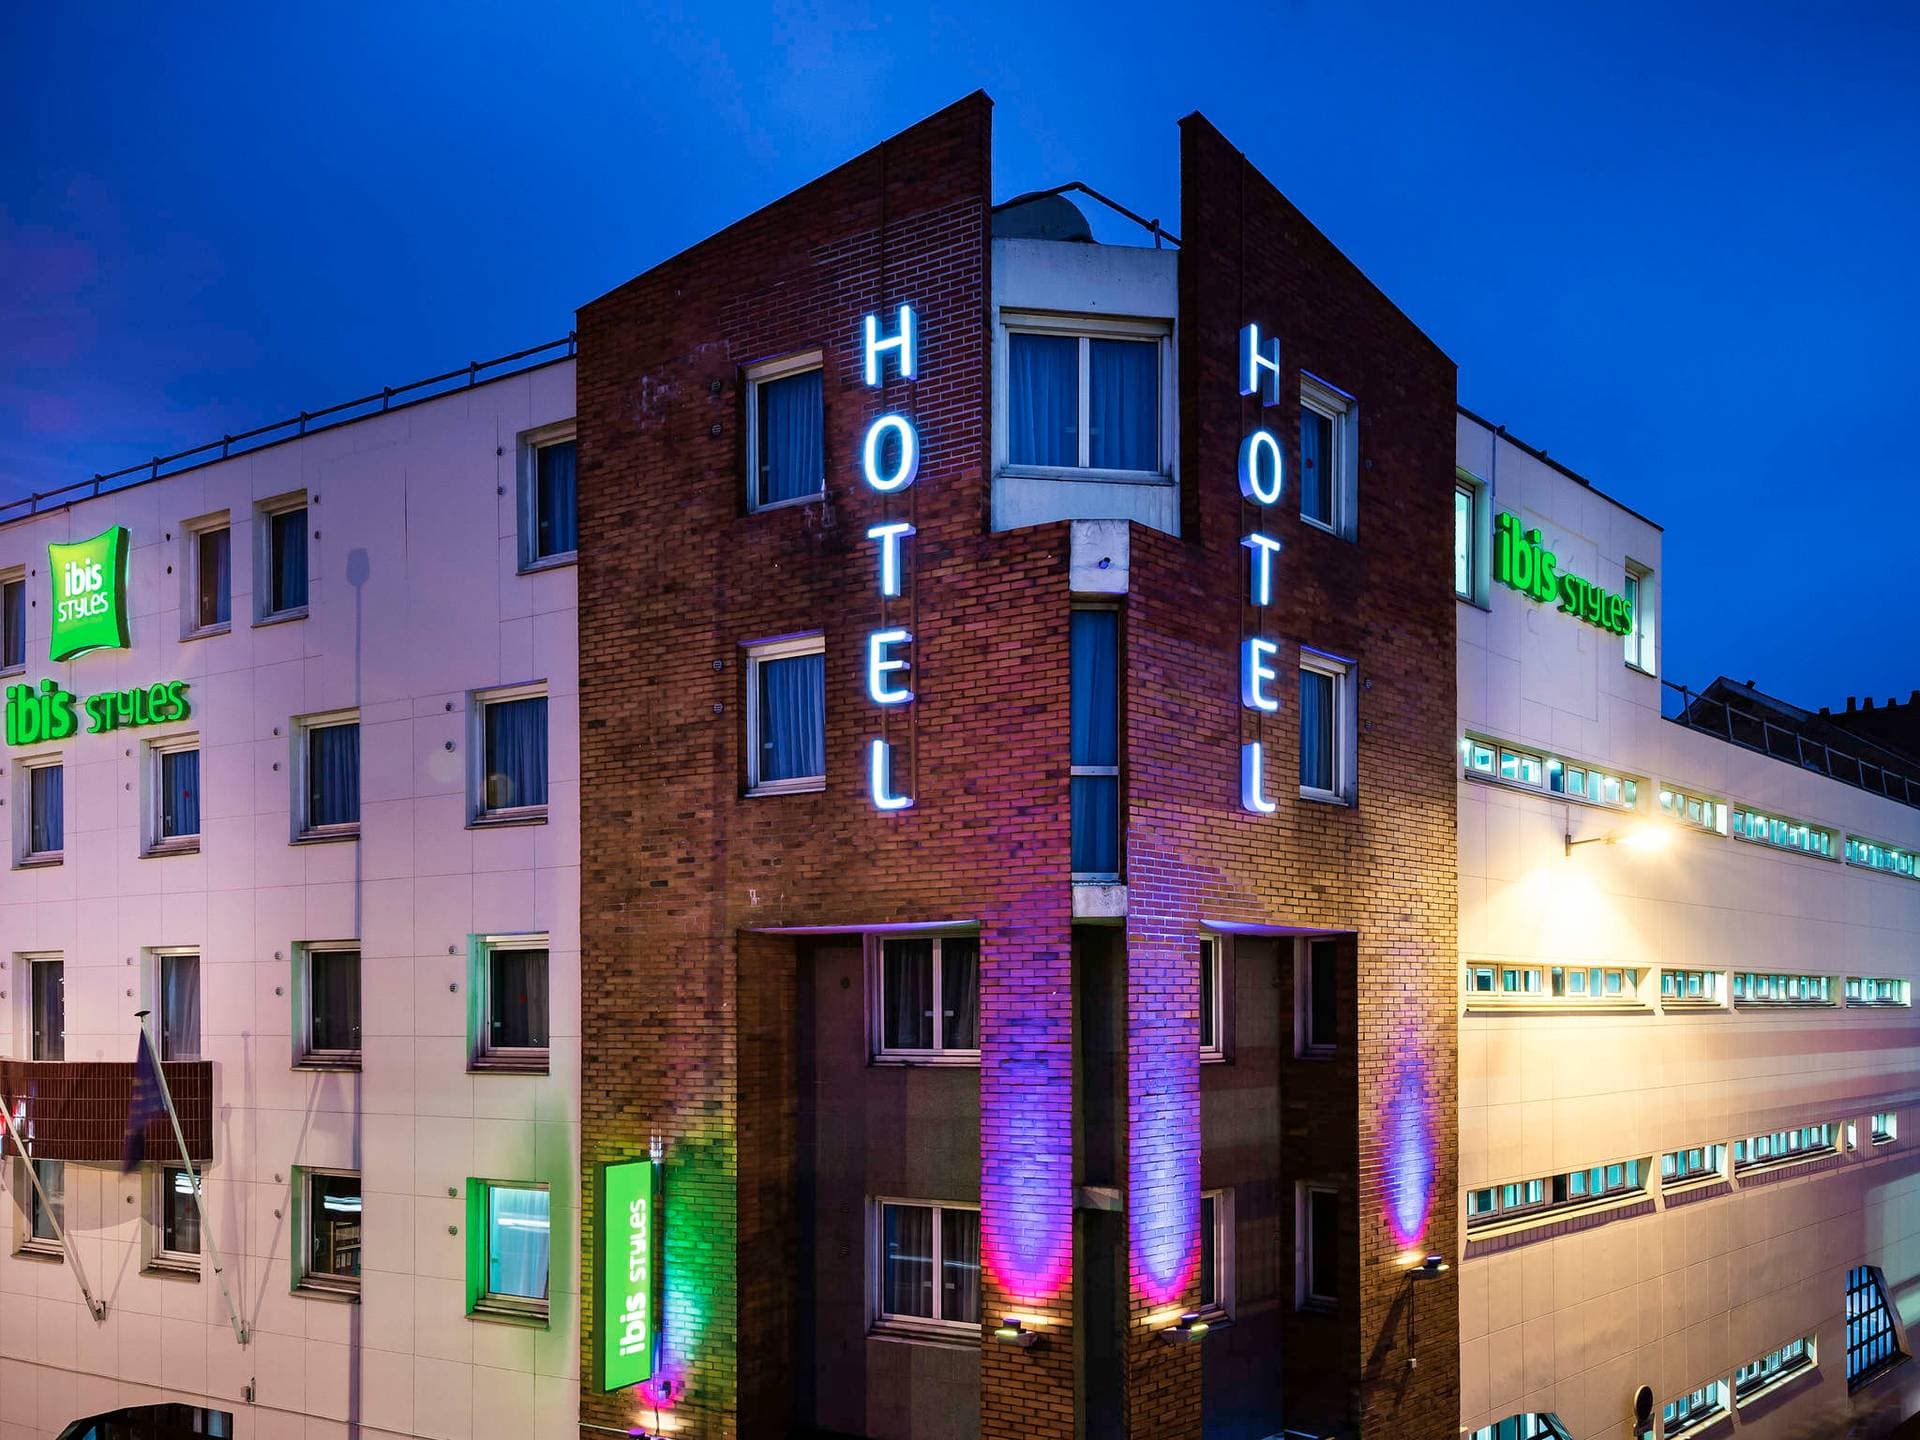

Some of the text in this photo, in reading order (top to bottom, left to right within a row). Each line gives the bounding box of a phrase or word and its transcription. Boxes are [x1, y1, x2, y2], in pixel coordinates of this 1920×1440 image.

[64, 558, 103, 597] ibis
[864, 304, 918, 811] HOTEL
[1240, 323, 1283, 813] HOTEL
[1495, 512, 1559, 603] ibis
[6, 679, 75, 745] ibis
[619, 1292, 647, 1357] ibis
